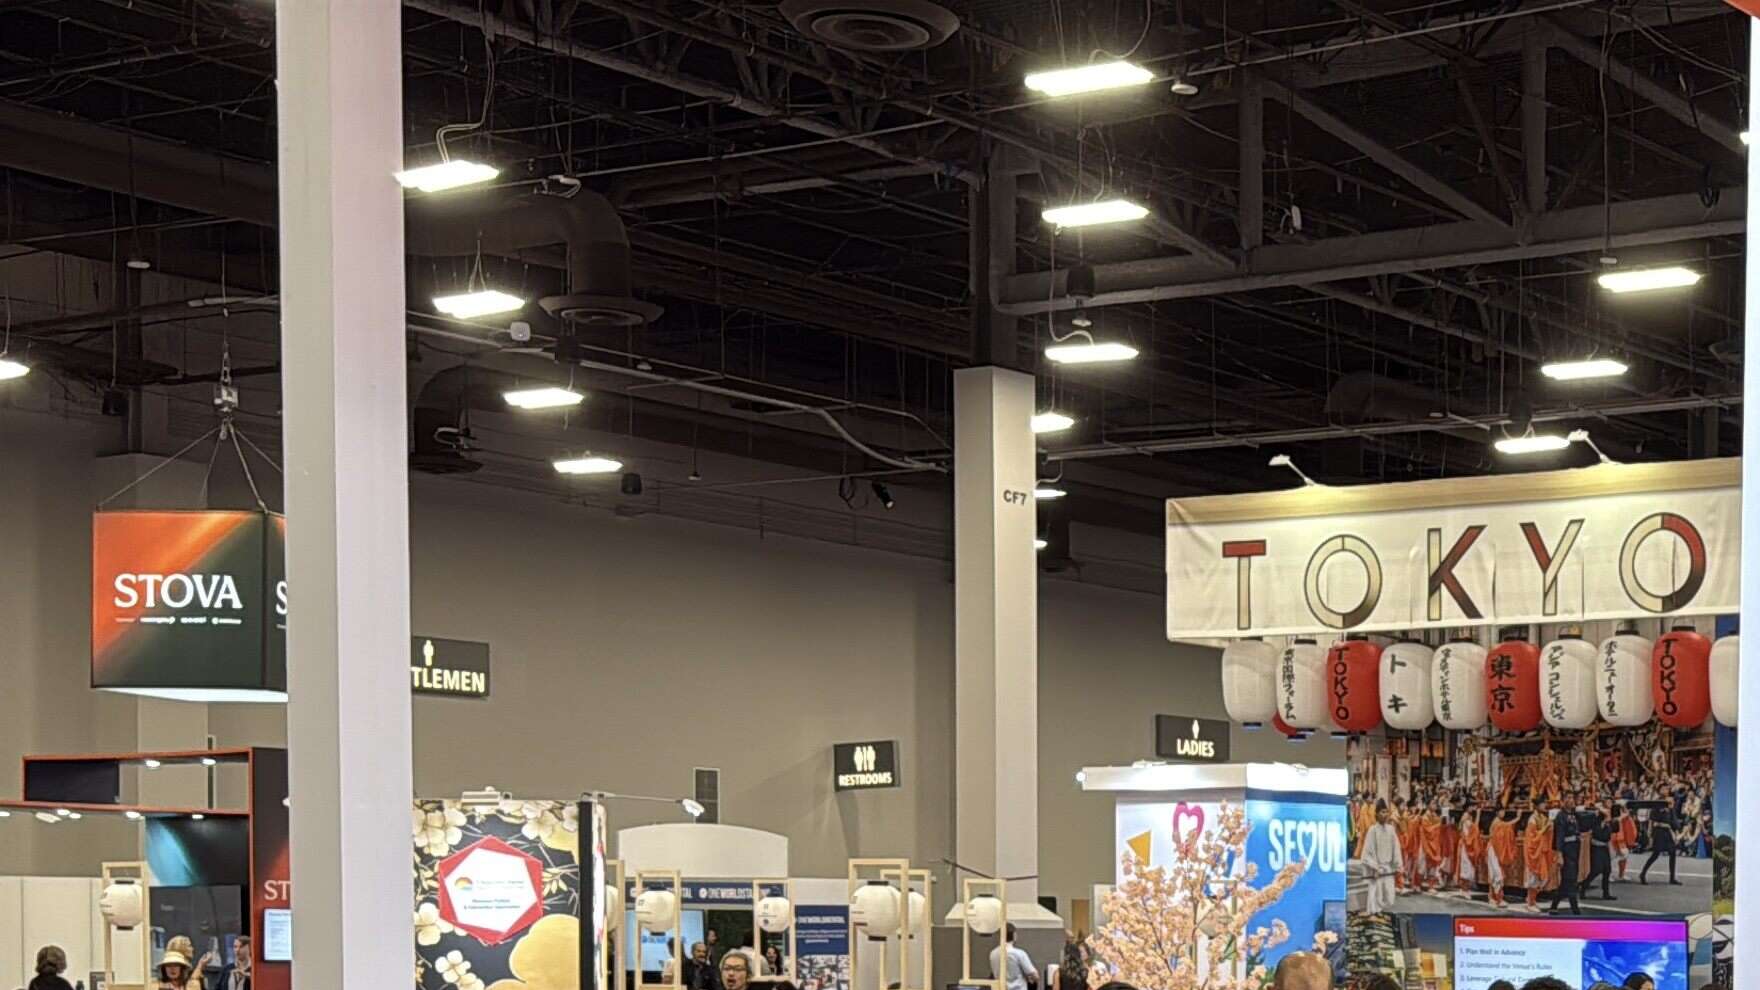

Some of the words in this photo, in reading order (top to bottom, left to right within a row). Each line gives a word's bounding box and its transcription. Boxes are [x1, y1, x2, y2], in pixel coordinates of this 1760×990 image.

[1003, 489, 1028, 505] CF7
[1222, 512, 1708, 631] TOKYO
[114, 572, 244, 609] STOVA
[410, 666, 486, 693] TLEMEN
[1333, 647, 1350, 721] TOKYO
[1490, 654, 1517, 713] 東京
[1660, 637, 1680, 716] TOKYO
[1176, 738, 1215, 758] LADIES
[838, 771, 893, 787] RESTROOMS
[1459, 923, 1475, 935] Tips
